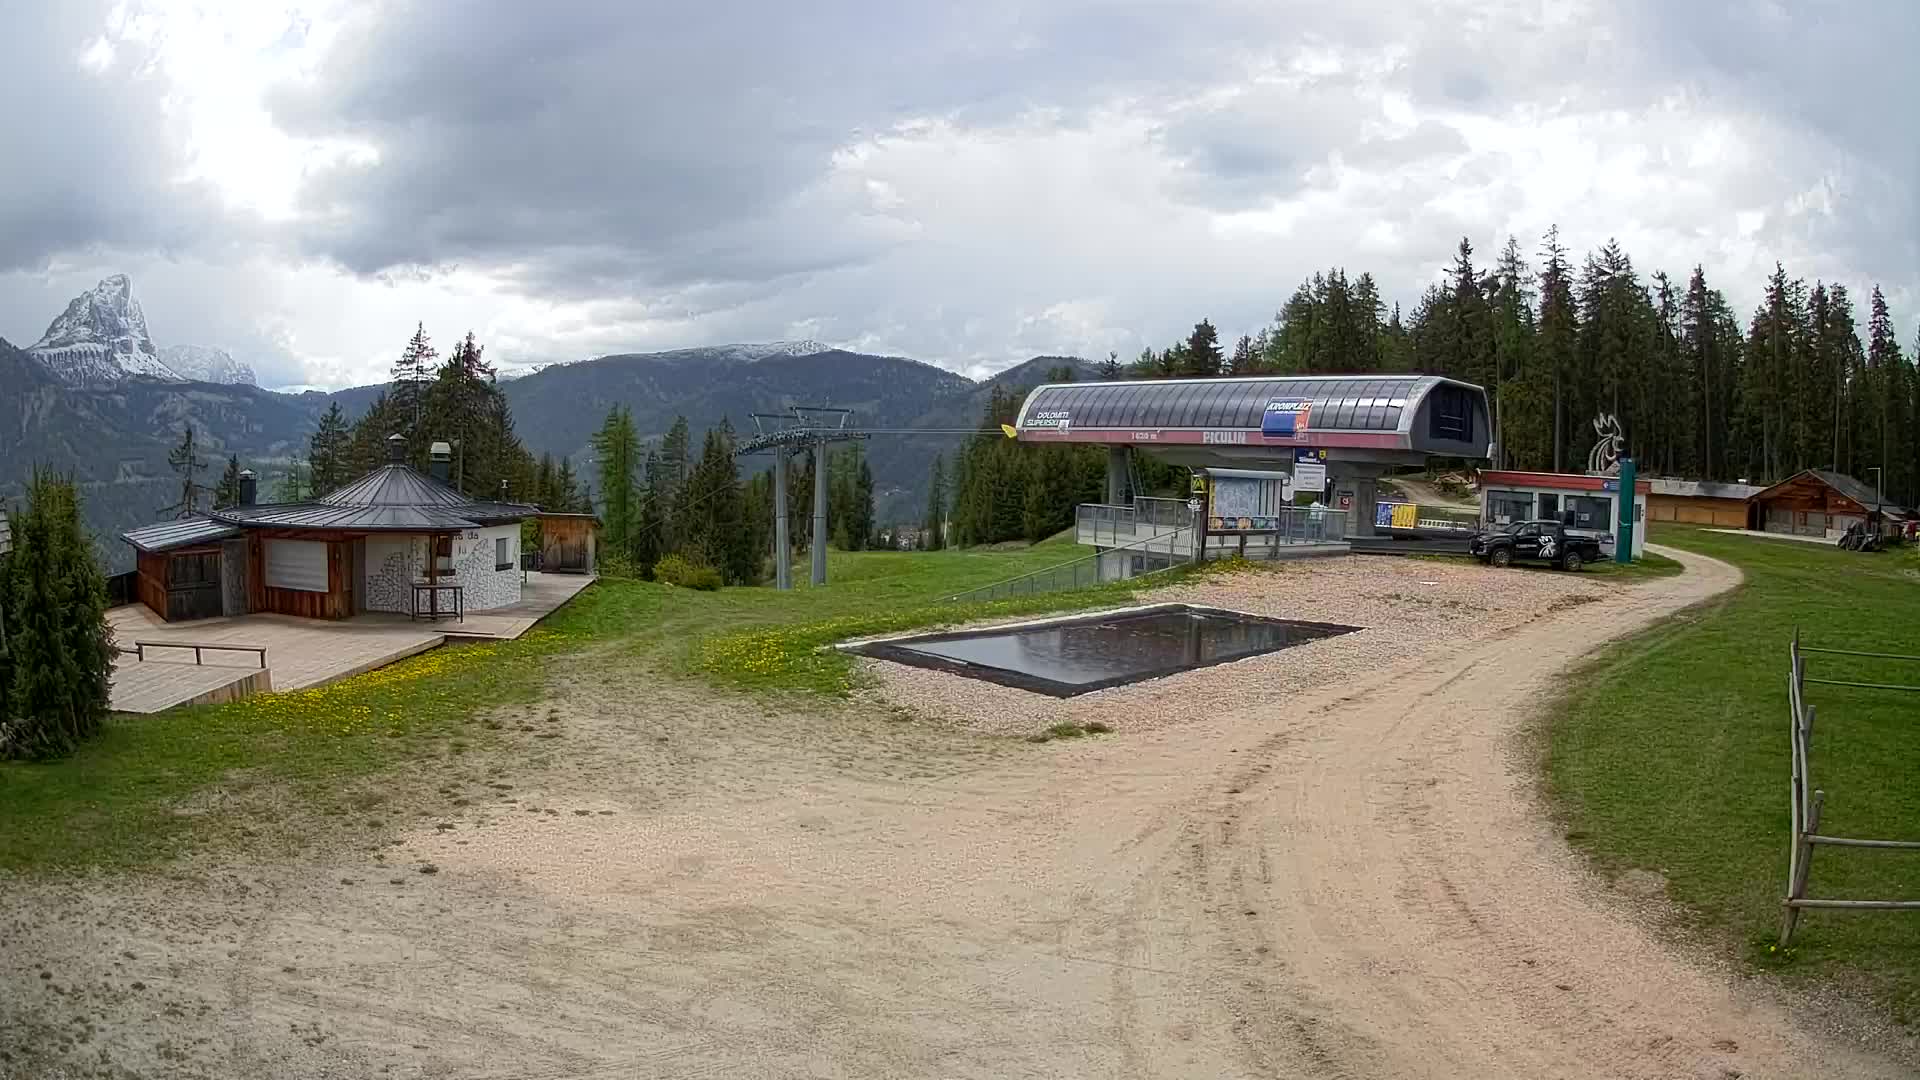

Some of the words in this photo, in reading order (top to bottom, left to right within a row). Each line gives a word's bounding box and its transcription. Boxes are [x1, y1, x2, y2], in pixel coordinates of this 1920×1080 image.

[1267, 402, 1312, 410] KRONPLATZ
[1037, 411, 1069, 419] DOLOMITI
[1203, 431, 1246, 444] PICULIN
